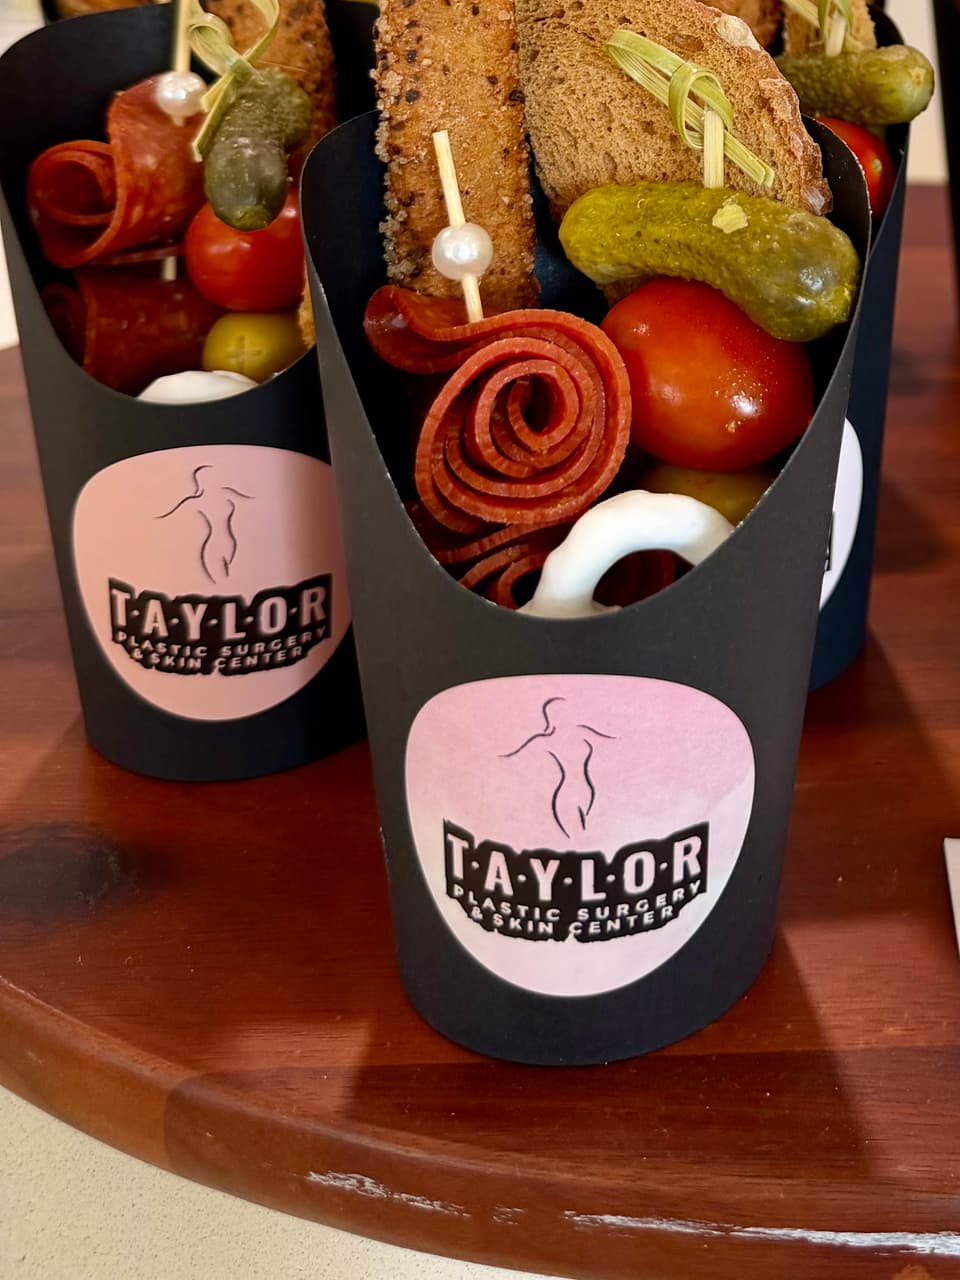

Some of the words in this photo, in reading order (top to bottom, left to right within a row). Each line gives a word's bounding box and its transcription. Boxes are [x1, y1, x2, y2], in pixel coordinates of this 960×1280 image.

[117, 631, 207, 656] PLASTIC
[222, 626, 326, 656] SURGERY
[152, 652, 201, 668] SKIN
[214, 646, 302, 669] CENTER
[453, 883, 561, 920] PLASTIC
[577, 880, 700, 920] SURGERY
[471, 908, 483, 919] &
[493, 914, 553, 933] SKIN
[569, 906, 673, 935] CENTER
